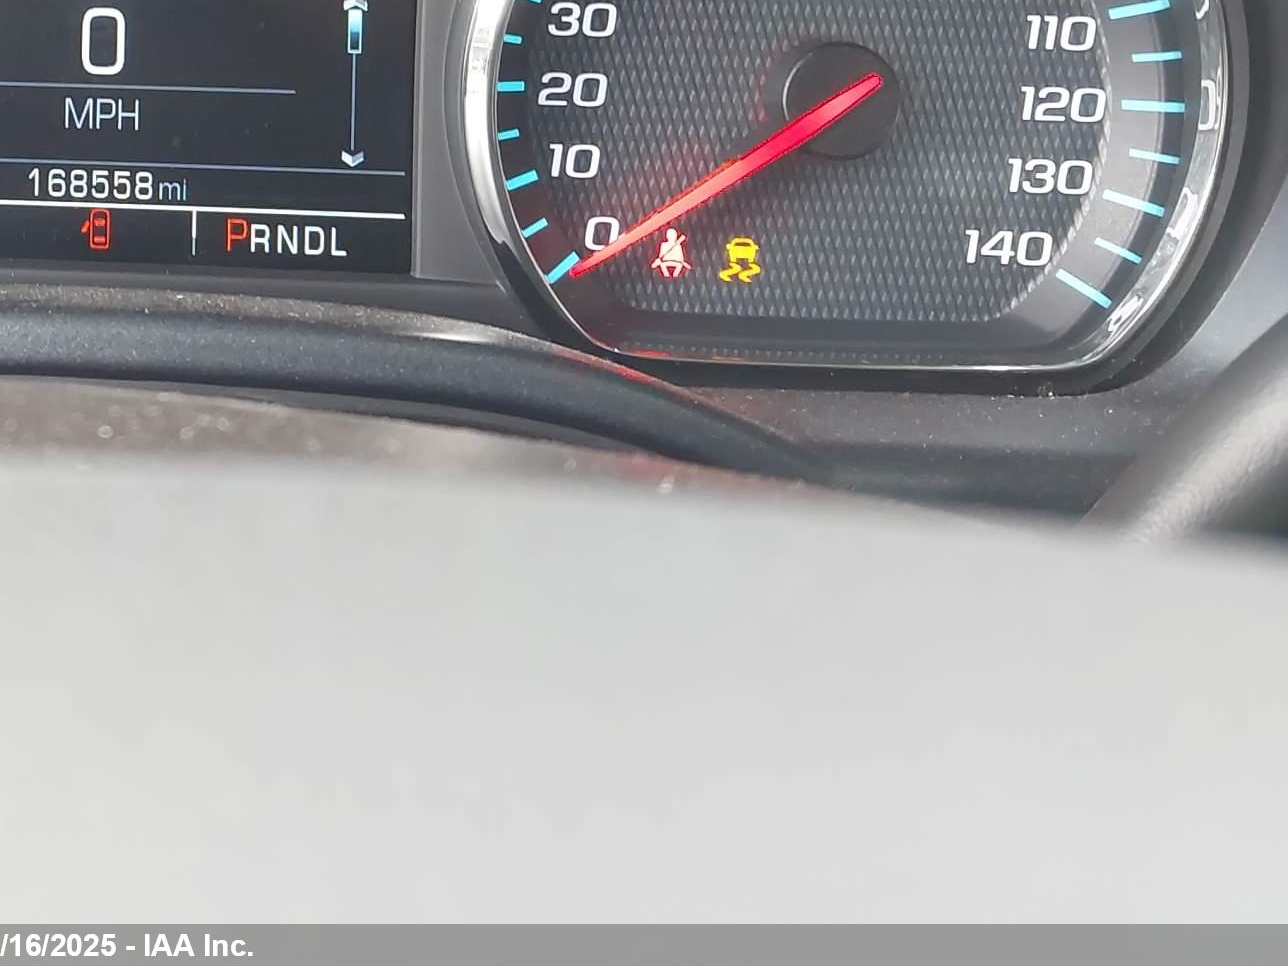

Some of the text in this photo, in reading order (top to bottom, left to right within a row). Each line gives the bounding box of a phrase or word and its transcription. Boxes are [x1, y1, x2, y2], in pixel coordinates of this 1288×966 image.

[548, 1, 618, 38] 30
[1026, 14, 1098, 52] 110
[80, 6, 127, 76] 0
[537, 72, 609, 108] 20
[1021, 85, 1108, 123] 120
[64, 97, 140, 132] MPH
[549, 143, 602, 180] 10
[1008, 157, 1094, 197] 130
[27, 167, 188, 201] 168558 mi
[226, 217, 347, 257] PRNDL
[584, 216, 620, 251] 0
[965, 229, 1054, 267] 140
